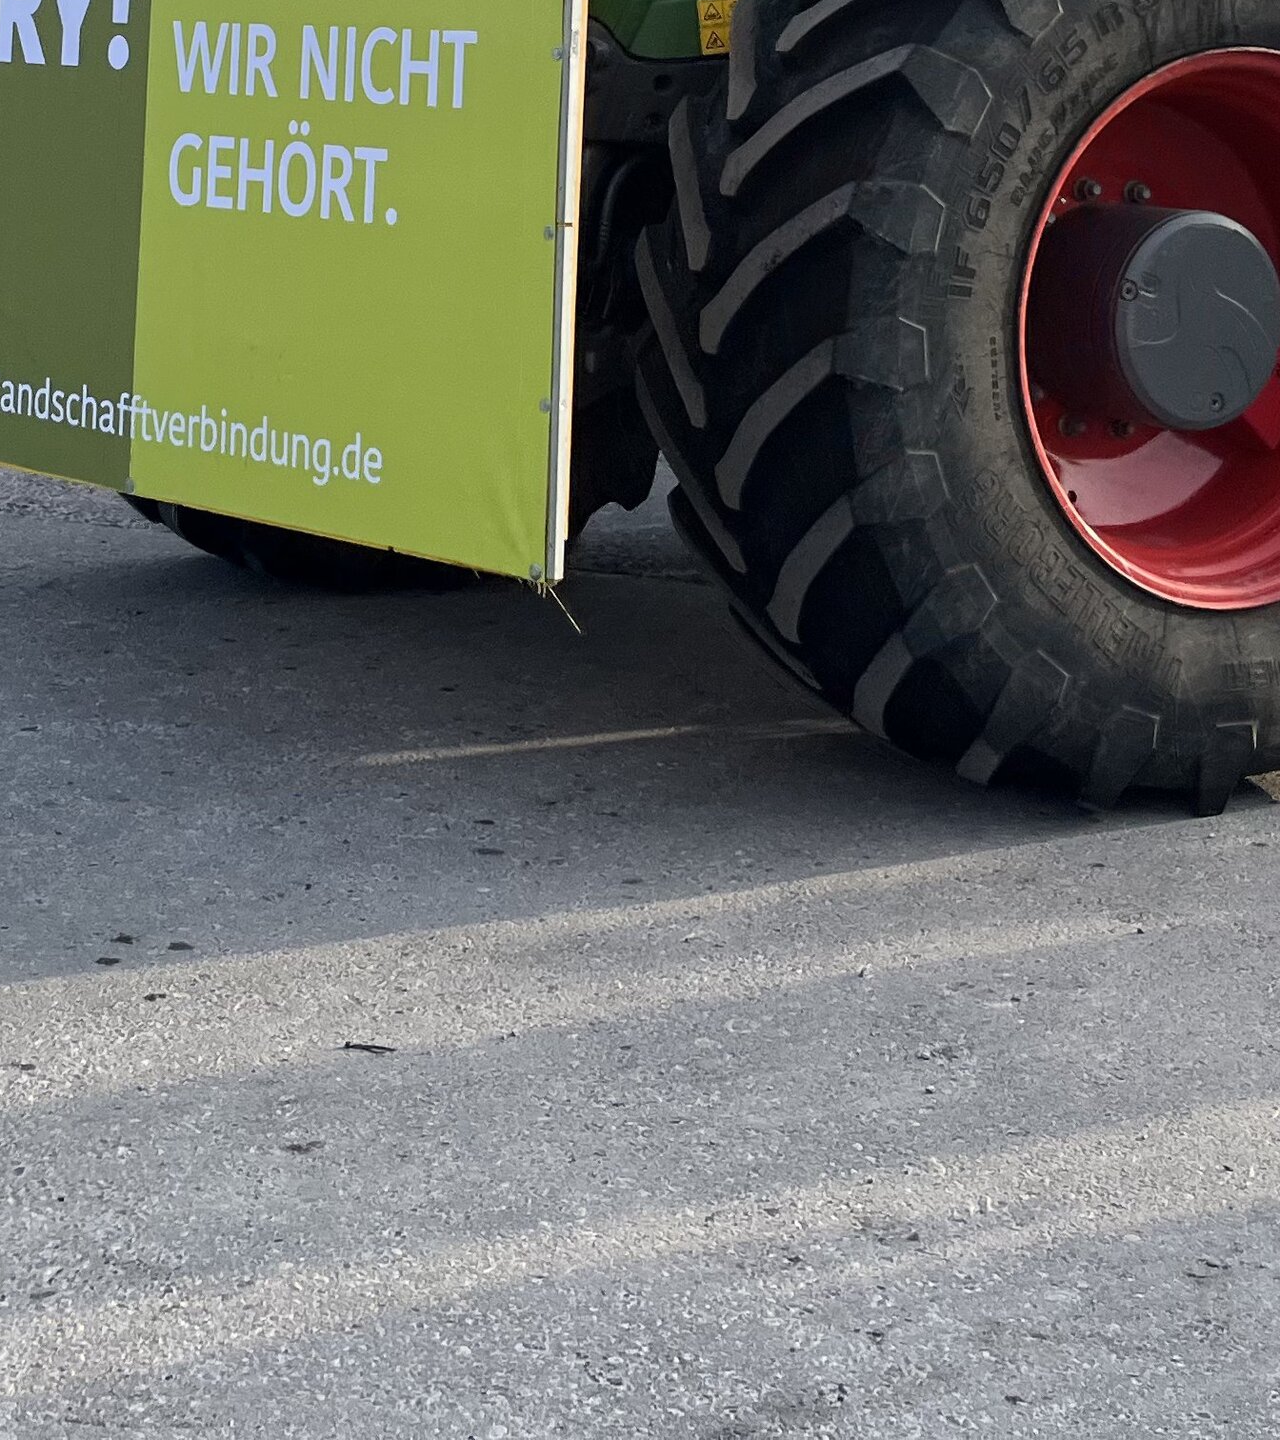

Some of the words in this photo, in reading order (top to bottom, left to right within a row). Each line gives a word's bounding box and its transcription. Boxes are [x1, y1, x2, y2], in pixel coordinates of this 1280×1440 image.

[172, 20, 278, 98] WIR
[299, 24, 478, 109] NICHT
[168, 119, 398, 226] GEHÖRT.
